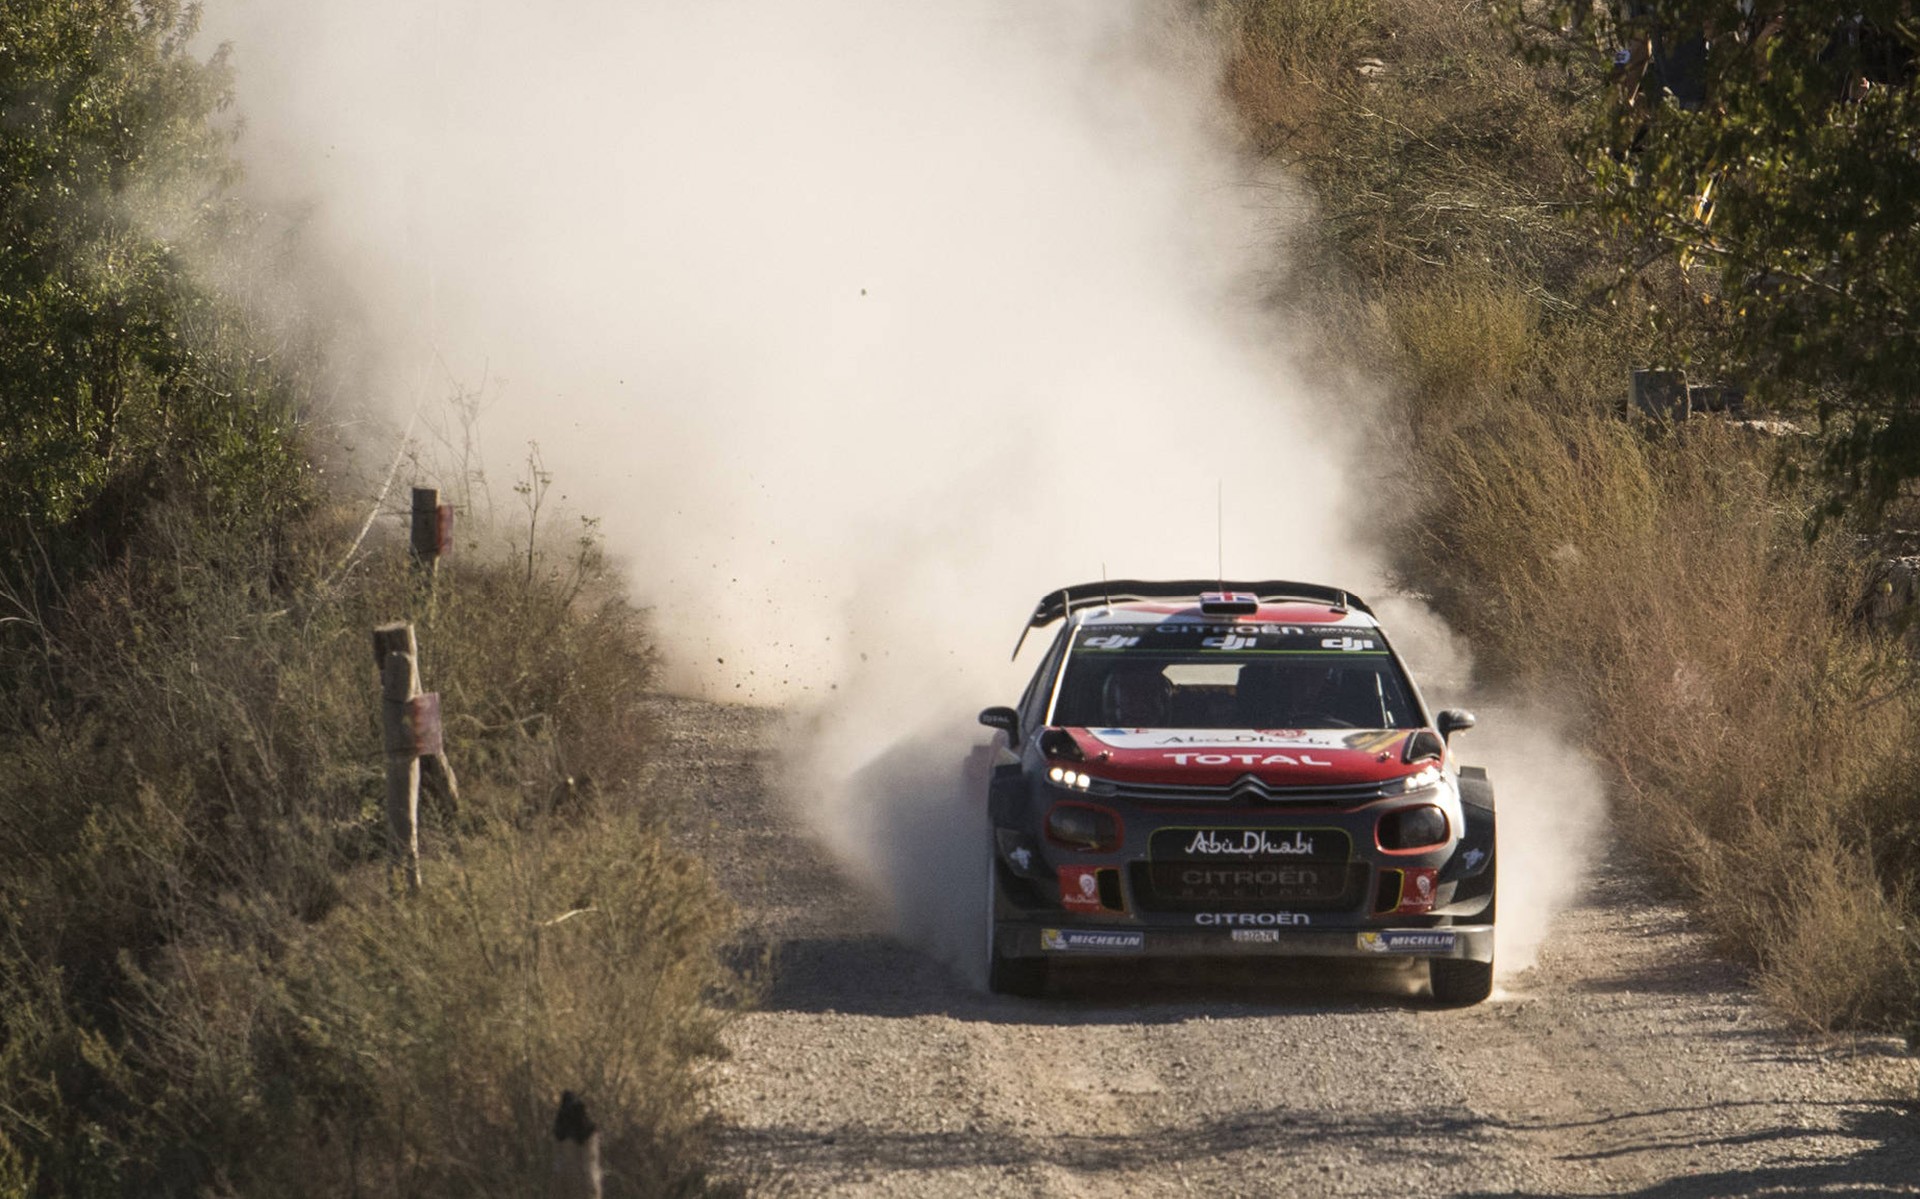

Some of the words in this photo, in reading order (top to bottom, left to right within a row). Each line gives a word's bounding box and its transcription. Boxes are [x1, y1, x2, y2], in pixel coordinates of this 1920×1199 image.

[1163, 752, 1332, 766] TOTAL
[1195, 910, 1311, 925] CITROËN
[1069, 935, 1140, 946] MICHELIN
[1389, 936, 1454, 946] MICHELIN
